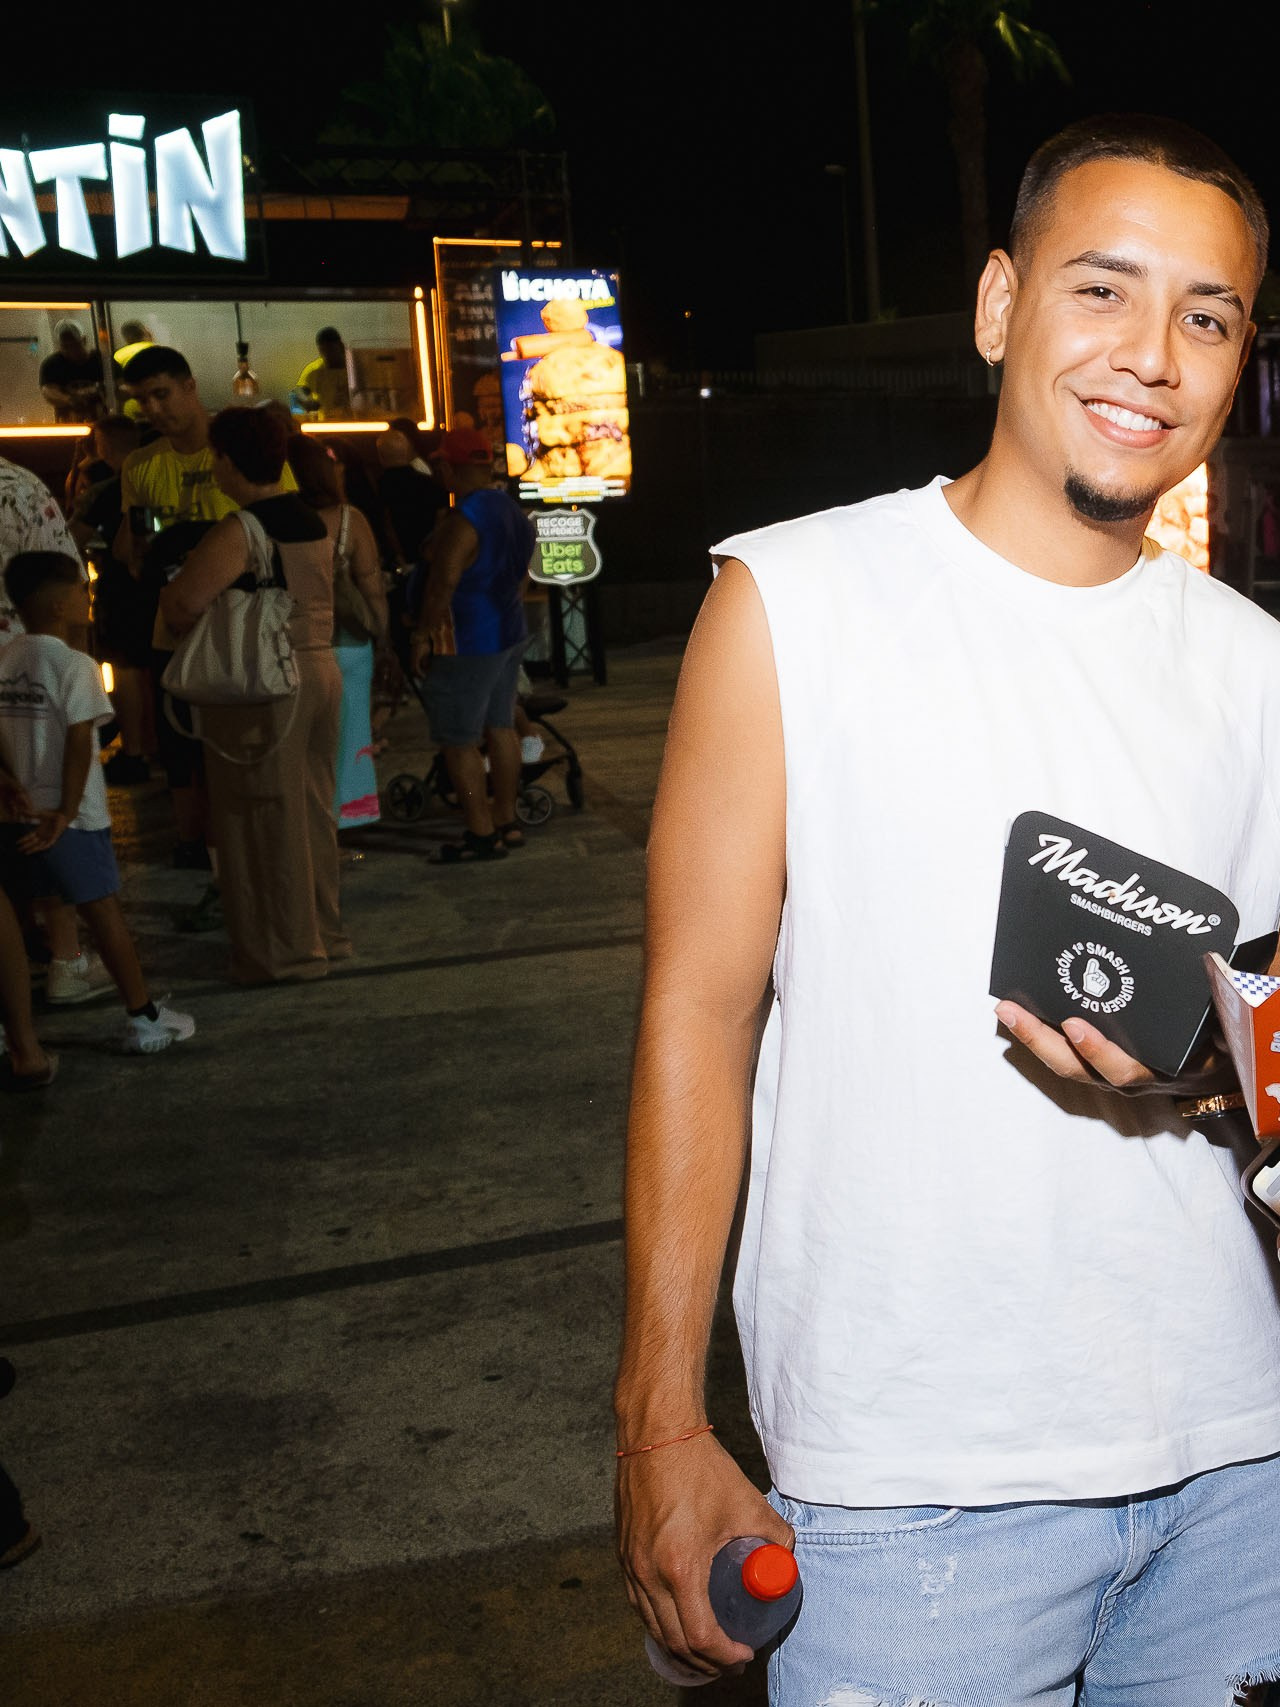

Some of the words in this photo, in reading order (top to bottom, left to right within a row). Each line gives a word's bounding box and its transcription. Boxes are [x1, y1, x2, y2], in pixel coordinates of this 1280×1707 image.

[537, 516, 584, 528] RECOGE
[540, 542, 583, 558] Uber
[541, 558, 585, 574] Eats
[1027, 833, 1213, 935] Madison
[1069, 892, 1153, 937] SMASHBURGERS
[1055, 949, 1083, 1001] ARAGÓN
[1085, 941, 1131, 976] SMASH
[1080, 996, 1101, 1013] DE
[1100, 976, 1136, 1014] BURGER
